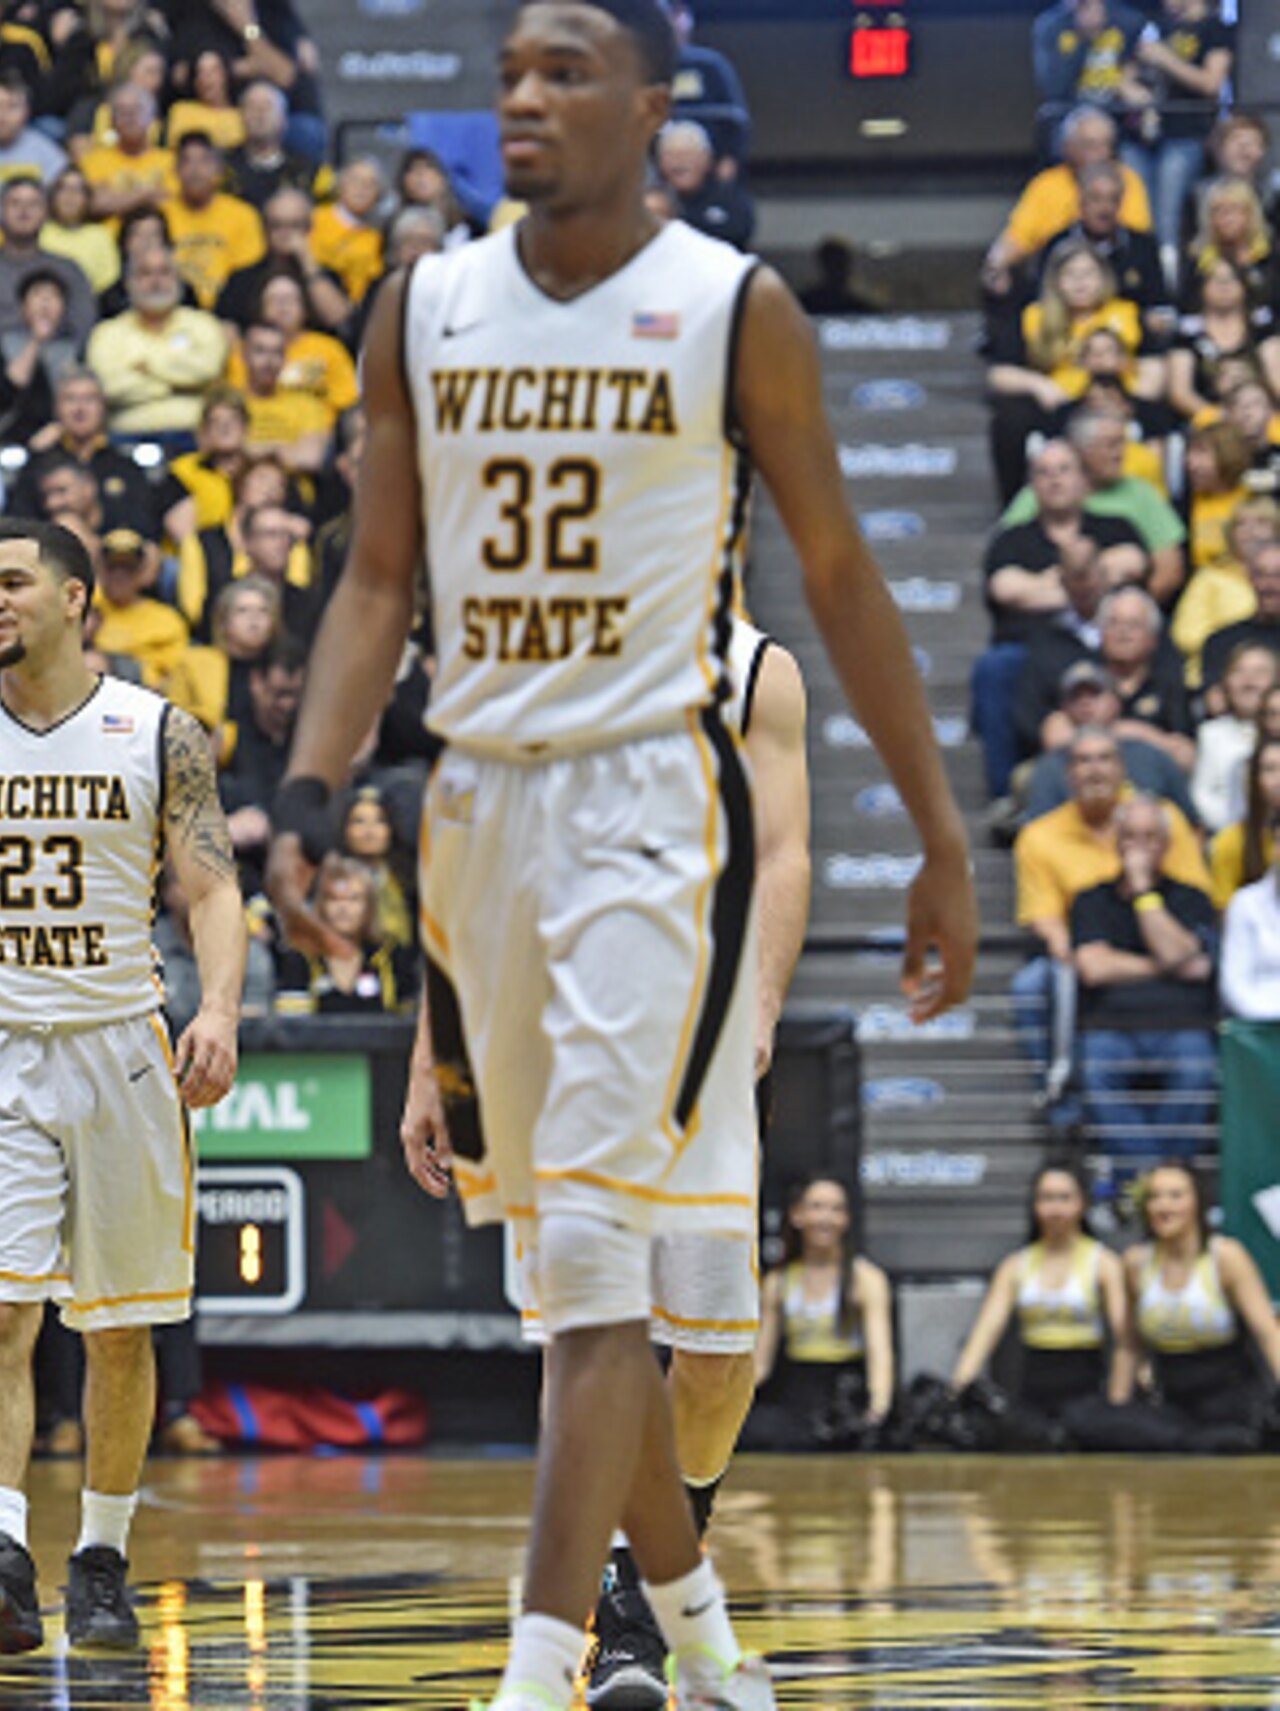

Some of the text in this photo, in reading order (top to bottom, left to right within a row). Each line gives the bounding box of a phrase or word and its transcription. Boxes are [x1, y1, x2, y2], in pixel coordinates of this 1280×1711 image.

[431, 368, 677, 436] WICHITA
[481, 455, 603, 573] 32
[462, 595, 629, 662] STATE
[240, 1222, 261, 1284] 1
